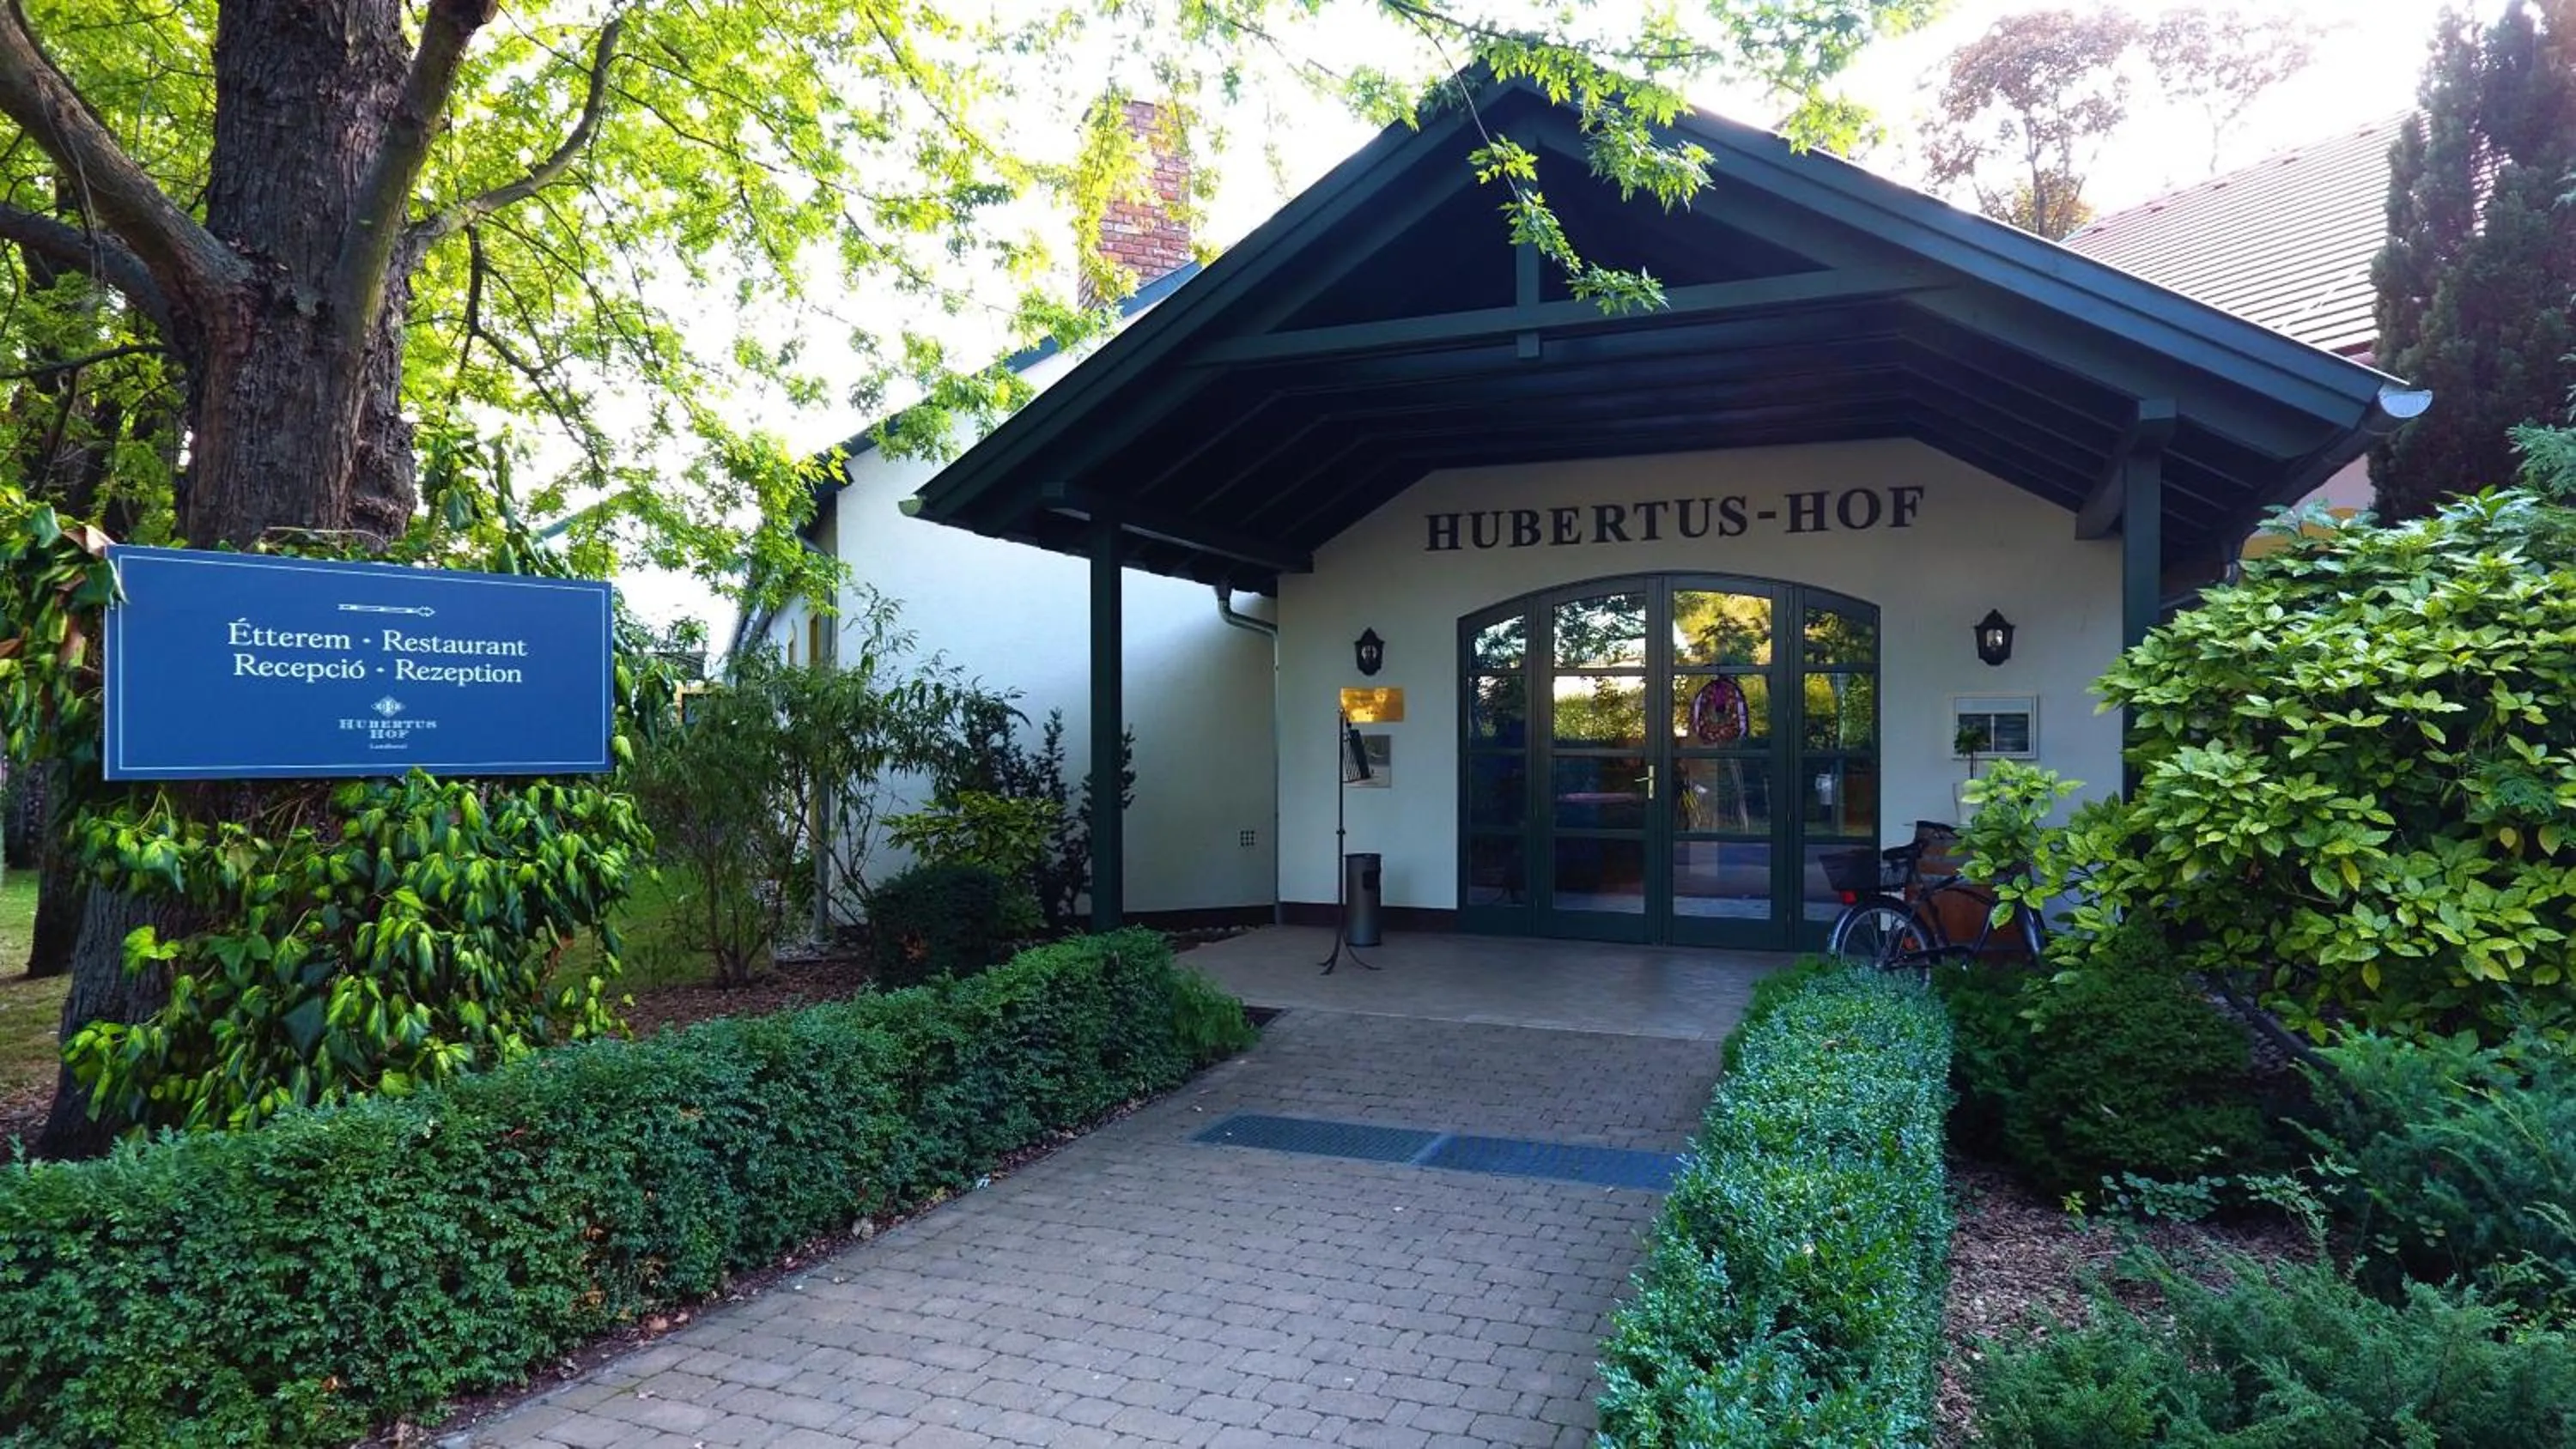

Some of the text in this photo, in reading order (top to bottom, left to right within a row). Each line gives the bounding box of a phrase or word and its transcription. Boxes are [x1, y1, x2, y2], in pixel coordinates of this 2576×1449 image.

[1425, 485, 1925, 551] HUBERTUS-HOF
[228, 617, 528, 657] Étterem Restaurant
[234, 652, 522, 687] Recepció Rezeption
[339, 718, 437, 730] HUBERTUS
[370, 729, 409, 739] HOF
